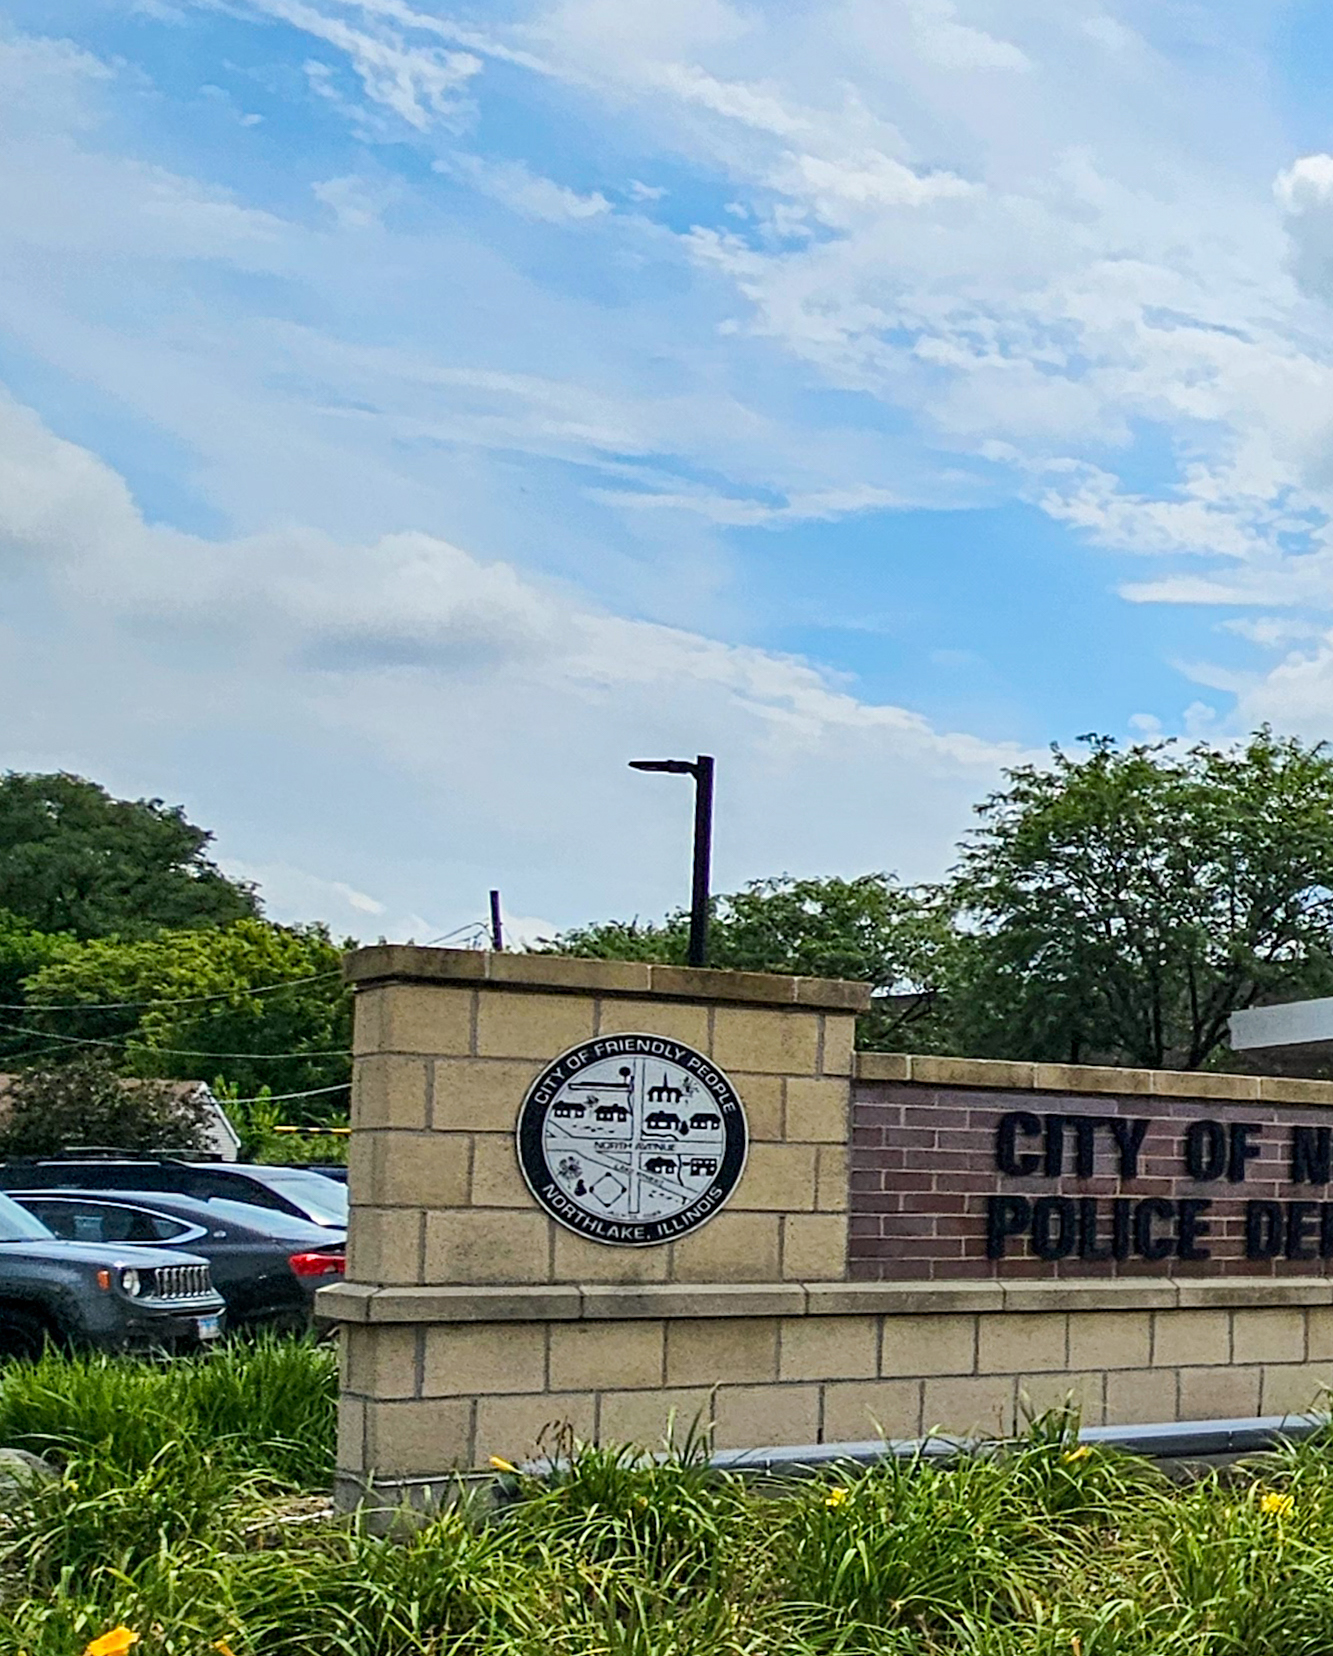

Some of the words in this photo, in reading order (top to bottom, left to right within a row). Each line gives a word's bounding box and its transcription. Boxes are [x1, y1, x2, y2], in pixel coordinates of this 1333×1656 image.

[534, 1067, 565, 1104] CITY
[566, 1049, 589, 1069] OF
[594, 1039, 686, 1060] FRIENDLY
[687, 1057, 736, 1114] PEOPLE
[995, 1110, 1149, 1180] CITY
[1183, 1119, 1263, 1183] OF
[542, 1184, 651, 1240] NORTHLAKE,
[656, 1186, 722, 1236] ILLINOIS
[983, 1195, 1213, 1260] POLICE
